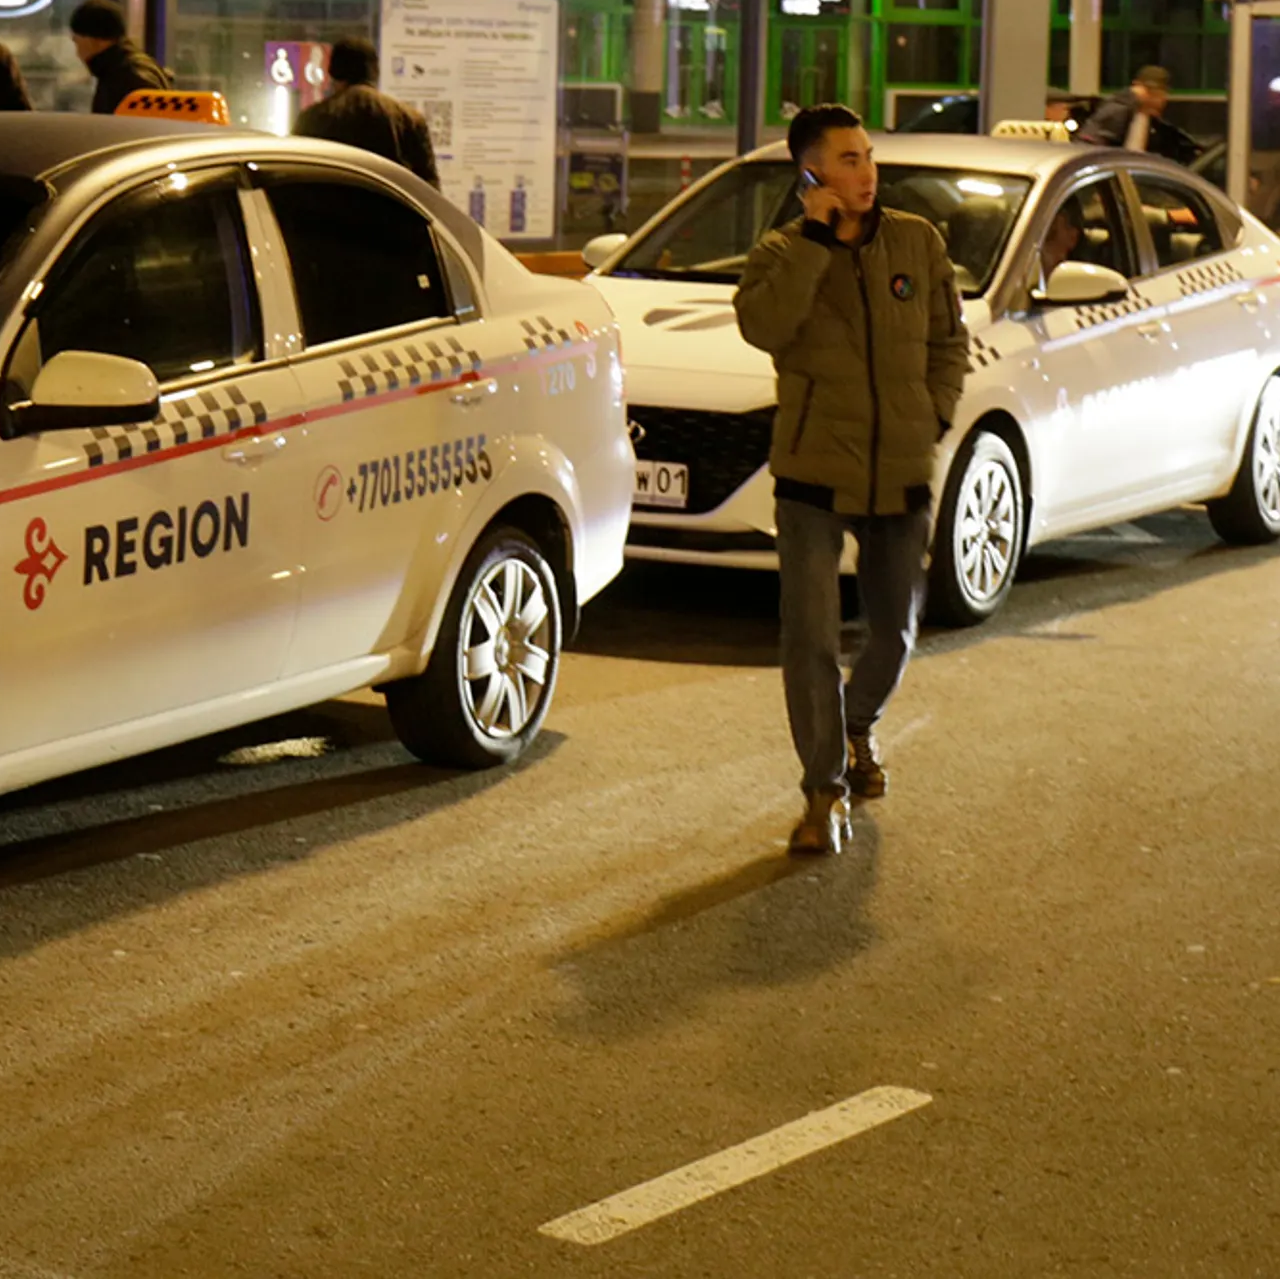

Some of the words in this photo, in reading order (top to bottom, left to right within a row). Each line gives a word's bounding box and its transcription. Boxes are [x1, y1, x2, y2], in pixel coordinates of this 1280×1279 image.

[346, 433, 493, 513] +77015555555
[657, 466, 686, 495] 01
[82, 491, 251, 587] REGION
